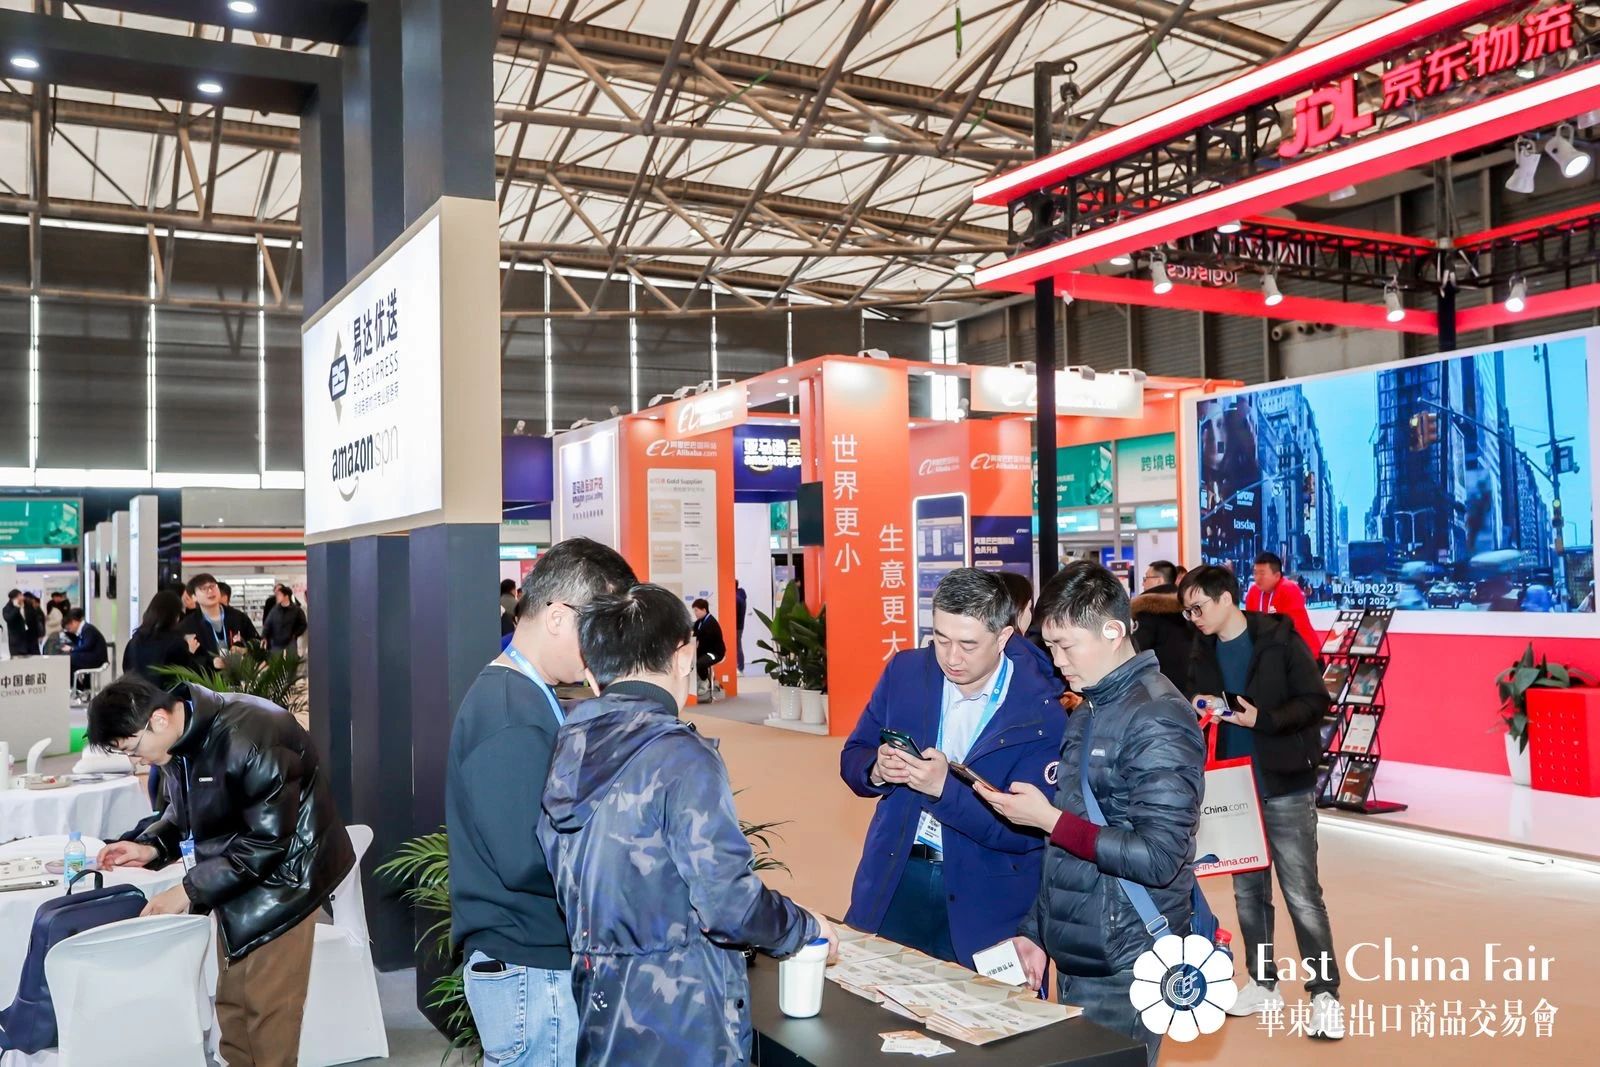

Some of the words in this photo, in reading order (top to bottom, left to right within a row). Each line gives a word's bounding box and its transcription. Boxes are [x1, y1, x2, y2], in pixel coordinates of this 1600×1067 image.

[1382, 3, 1577, 110] 京东物流
[353, 288, 398, 366] 易达优送
[366, 350, 399, 388] EXPRESS
[832, 434, 861, 573] 世界更小
[879, 523, 907, 661] 生意更大
[0, 672, 47, 689] 中国邮政
